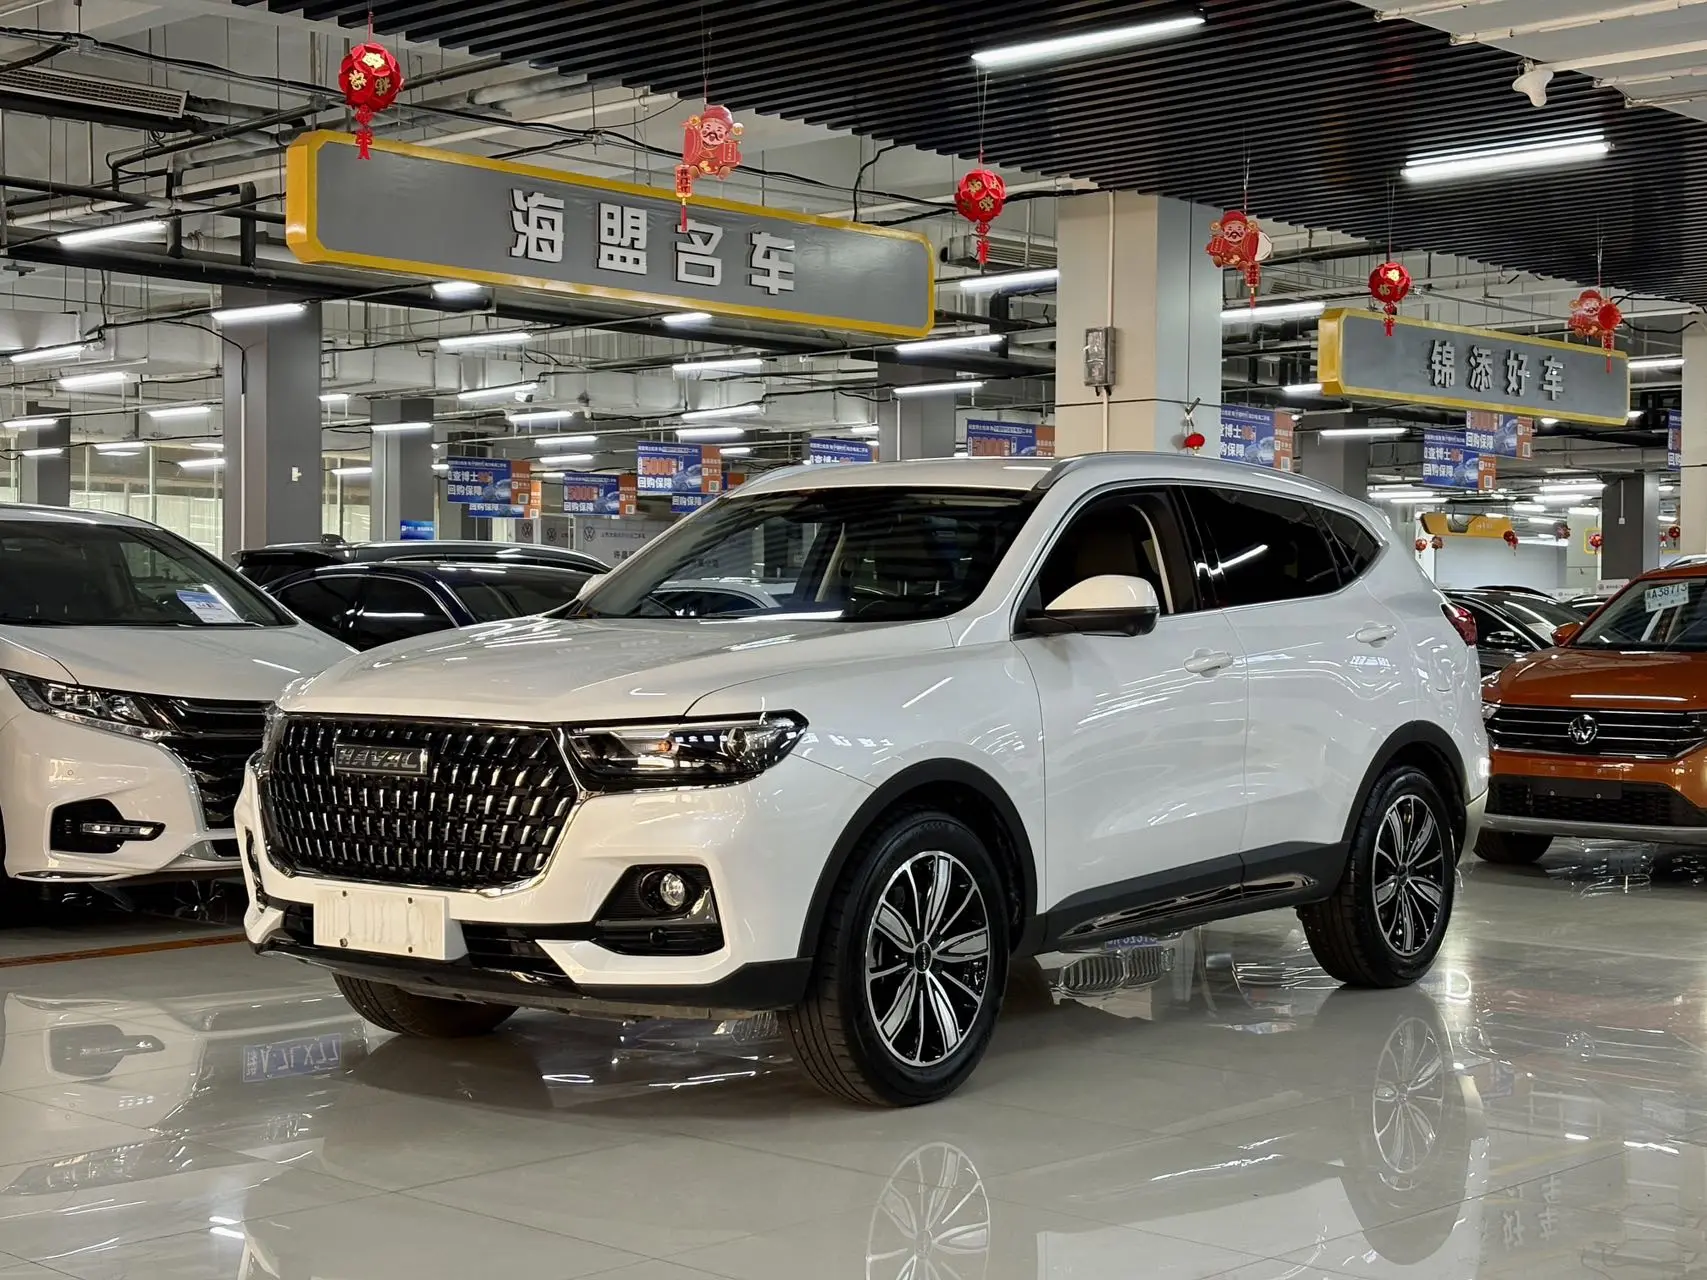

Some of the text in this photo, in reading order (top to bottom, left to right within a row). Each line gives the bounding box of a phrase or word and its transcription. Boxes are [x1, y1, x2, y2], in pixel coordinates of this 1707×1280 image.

[509, 188, 796, 296] 海盟名车
[1430, 340, 1564, 400] 锦添好车
[447, 484, 482, 496] 回购保障
[638, 477, 672, 489] 回购保障
